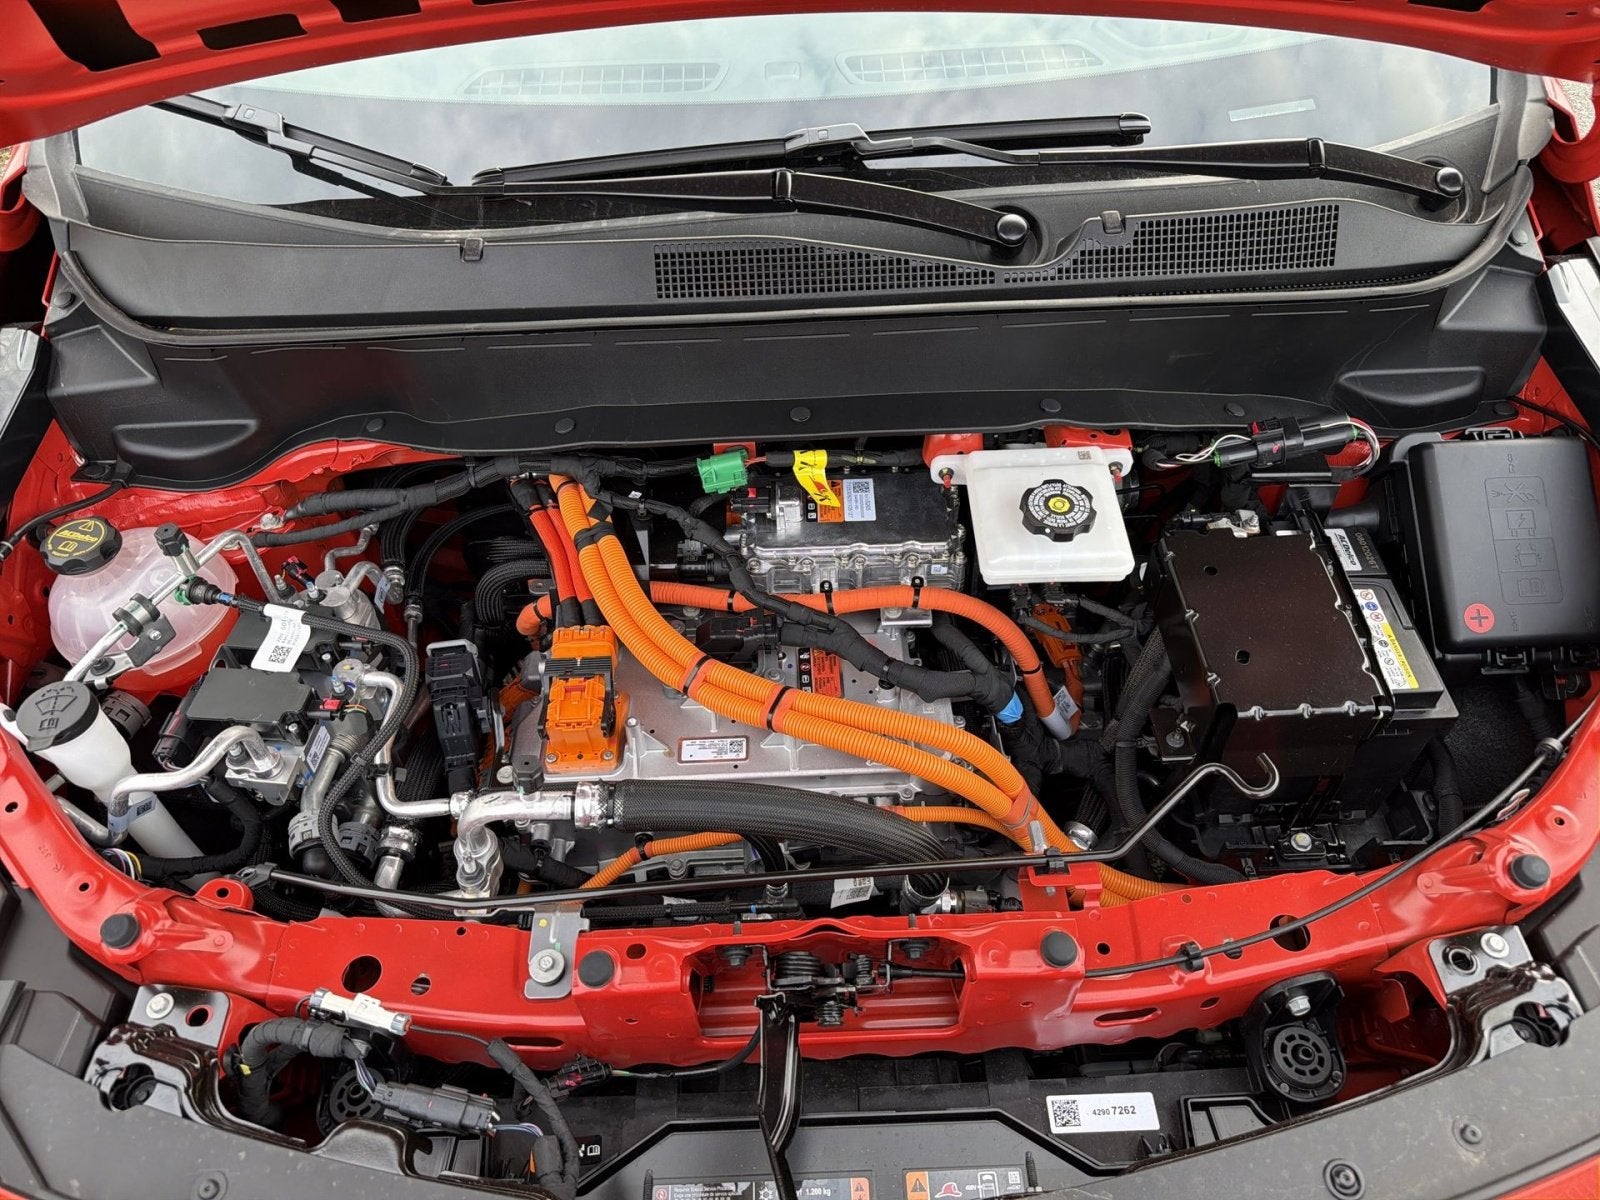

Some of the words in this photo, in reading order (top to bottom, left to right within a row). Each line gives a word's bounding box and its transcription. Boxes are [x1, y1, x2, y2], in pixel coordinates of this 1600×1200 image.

[57, 530, 99, 542] ACDelco
[1337, 534, 1357, 566] ACDelco
[1092, 1108, 1110, 1116] 4290
[1111, 1105, 1137, 1115] 7262
[805, 1187, 823, 1196] 1.200
[823, 1187, 831, 1197] kg
